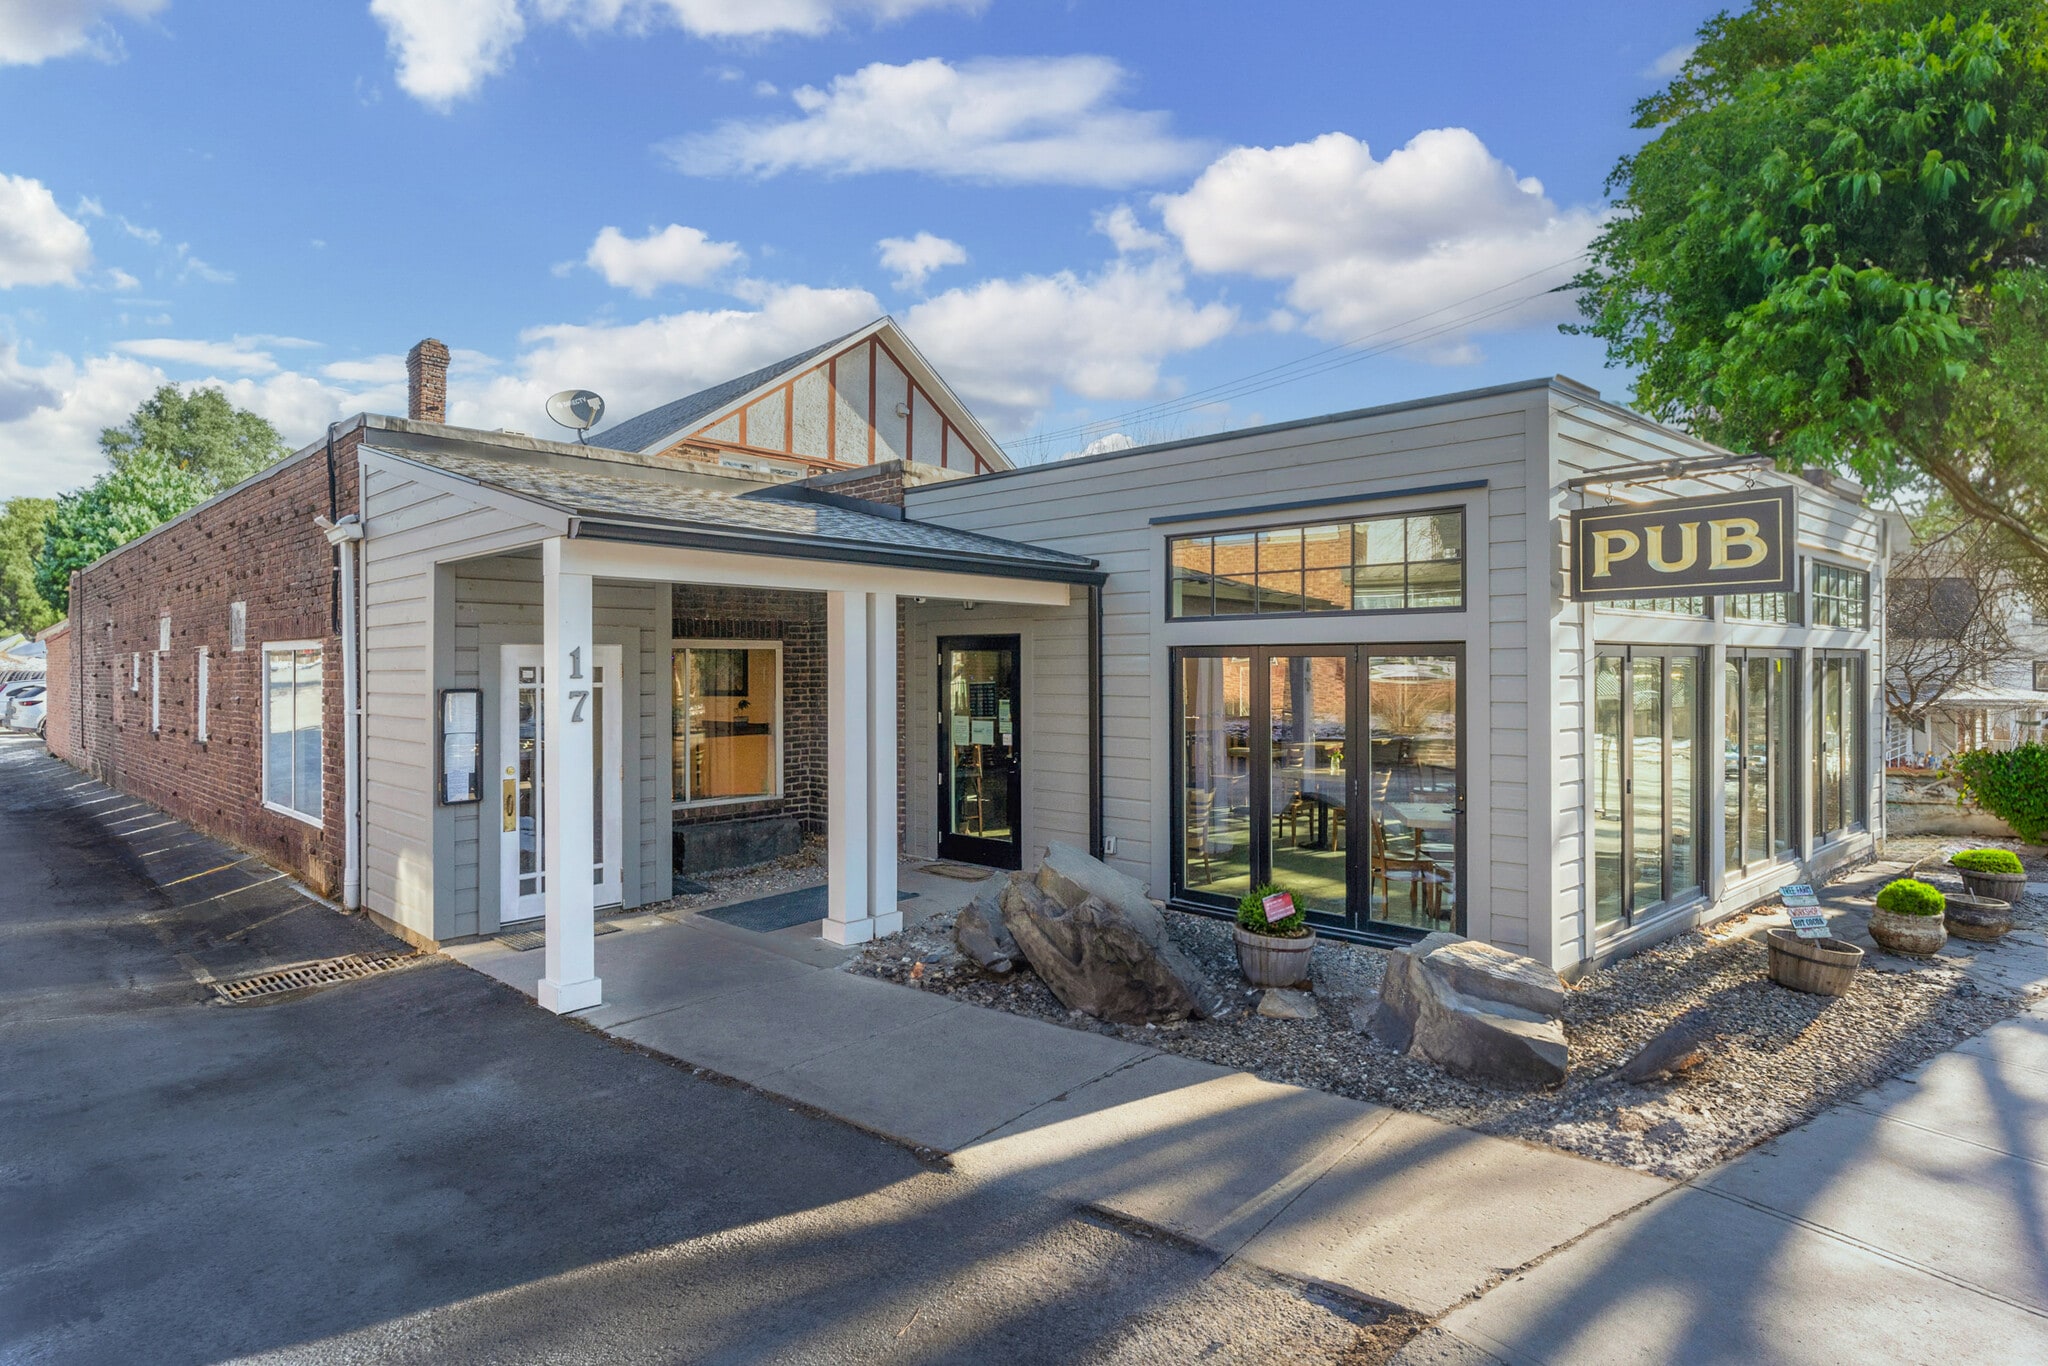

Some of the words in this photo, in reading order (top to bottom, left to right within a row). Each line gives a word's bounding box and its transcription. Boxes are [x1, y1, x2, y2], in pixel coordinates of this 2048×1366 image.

[1592, 517, 1768, 578] PUB
[568, 645, 590, 723] 17
[1781, 886, 1795, 895] TREE
[1793, 919, 1805, 927] HOT
[1806, 918, 1824, 926] COCOA
